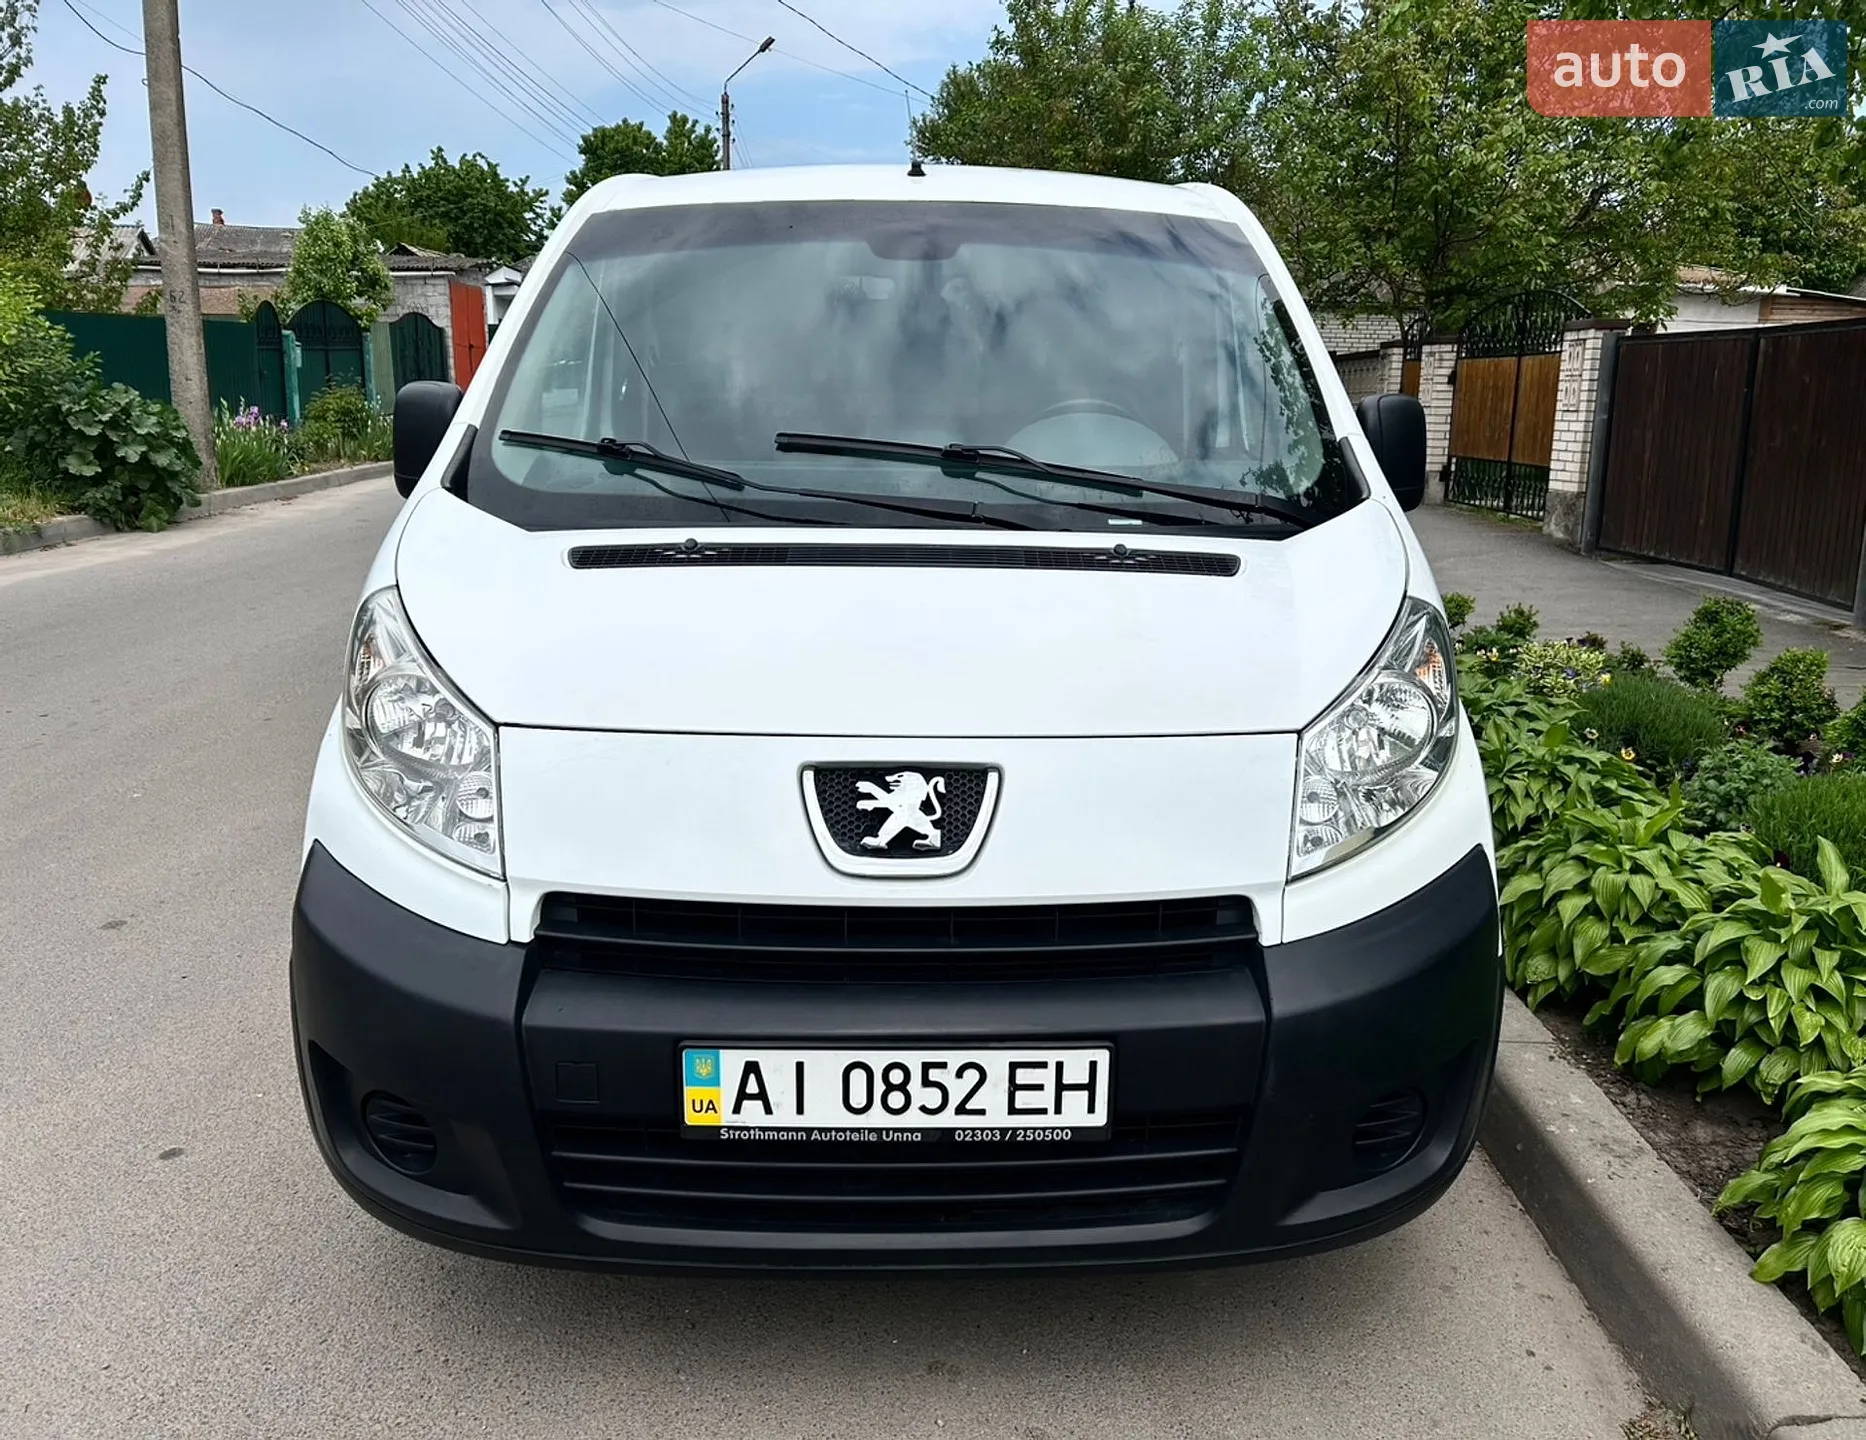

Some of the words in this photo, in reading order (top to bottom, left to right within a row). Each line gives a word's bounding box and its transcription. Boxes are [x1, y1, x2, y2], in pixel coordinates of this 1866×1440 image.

[732, 1060, 804, 1115] AI
[841, 1061, 988, 1116] 0852
[1007, 1060, 1098, 1115] EH
[692, 1099, 718, 1114] UA
[719, 1127, 807, 1141] Strothmann
[811, 1129, 878, 1142] Autoteile
[882, 1129, 922, 1142] Unna
[954, 1129, 1001, 1142] 02303
[1016, 1128, 1072, 1142] 250500
